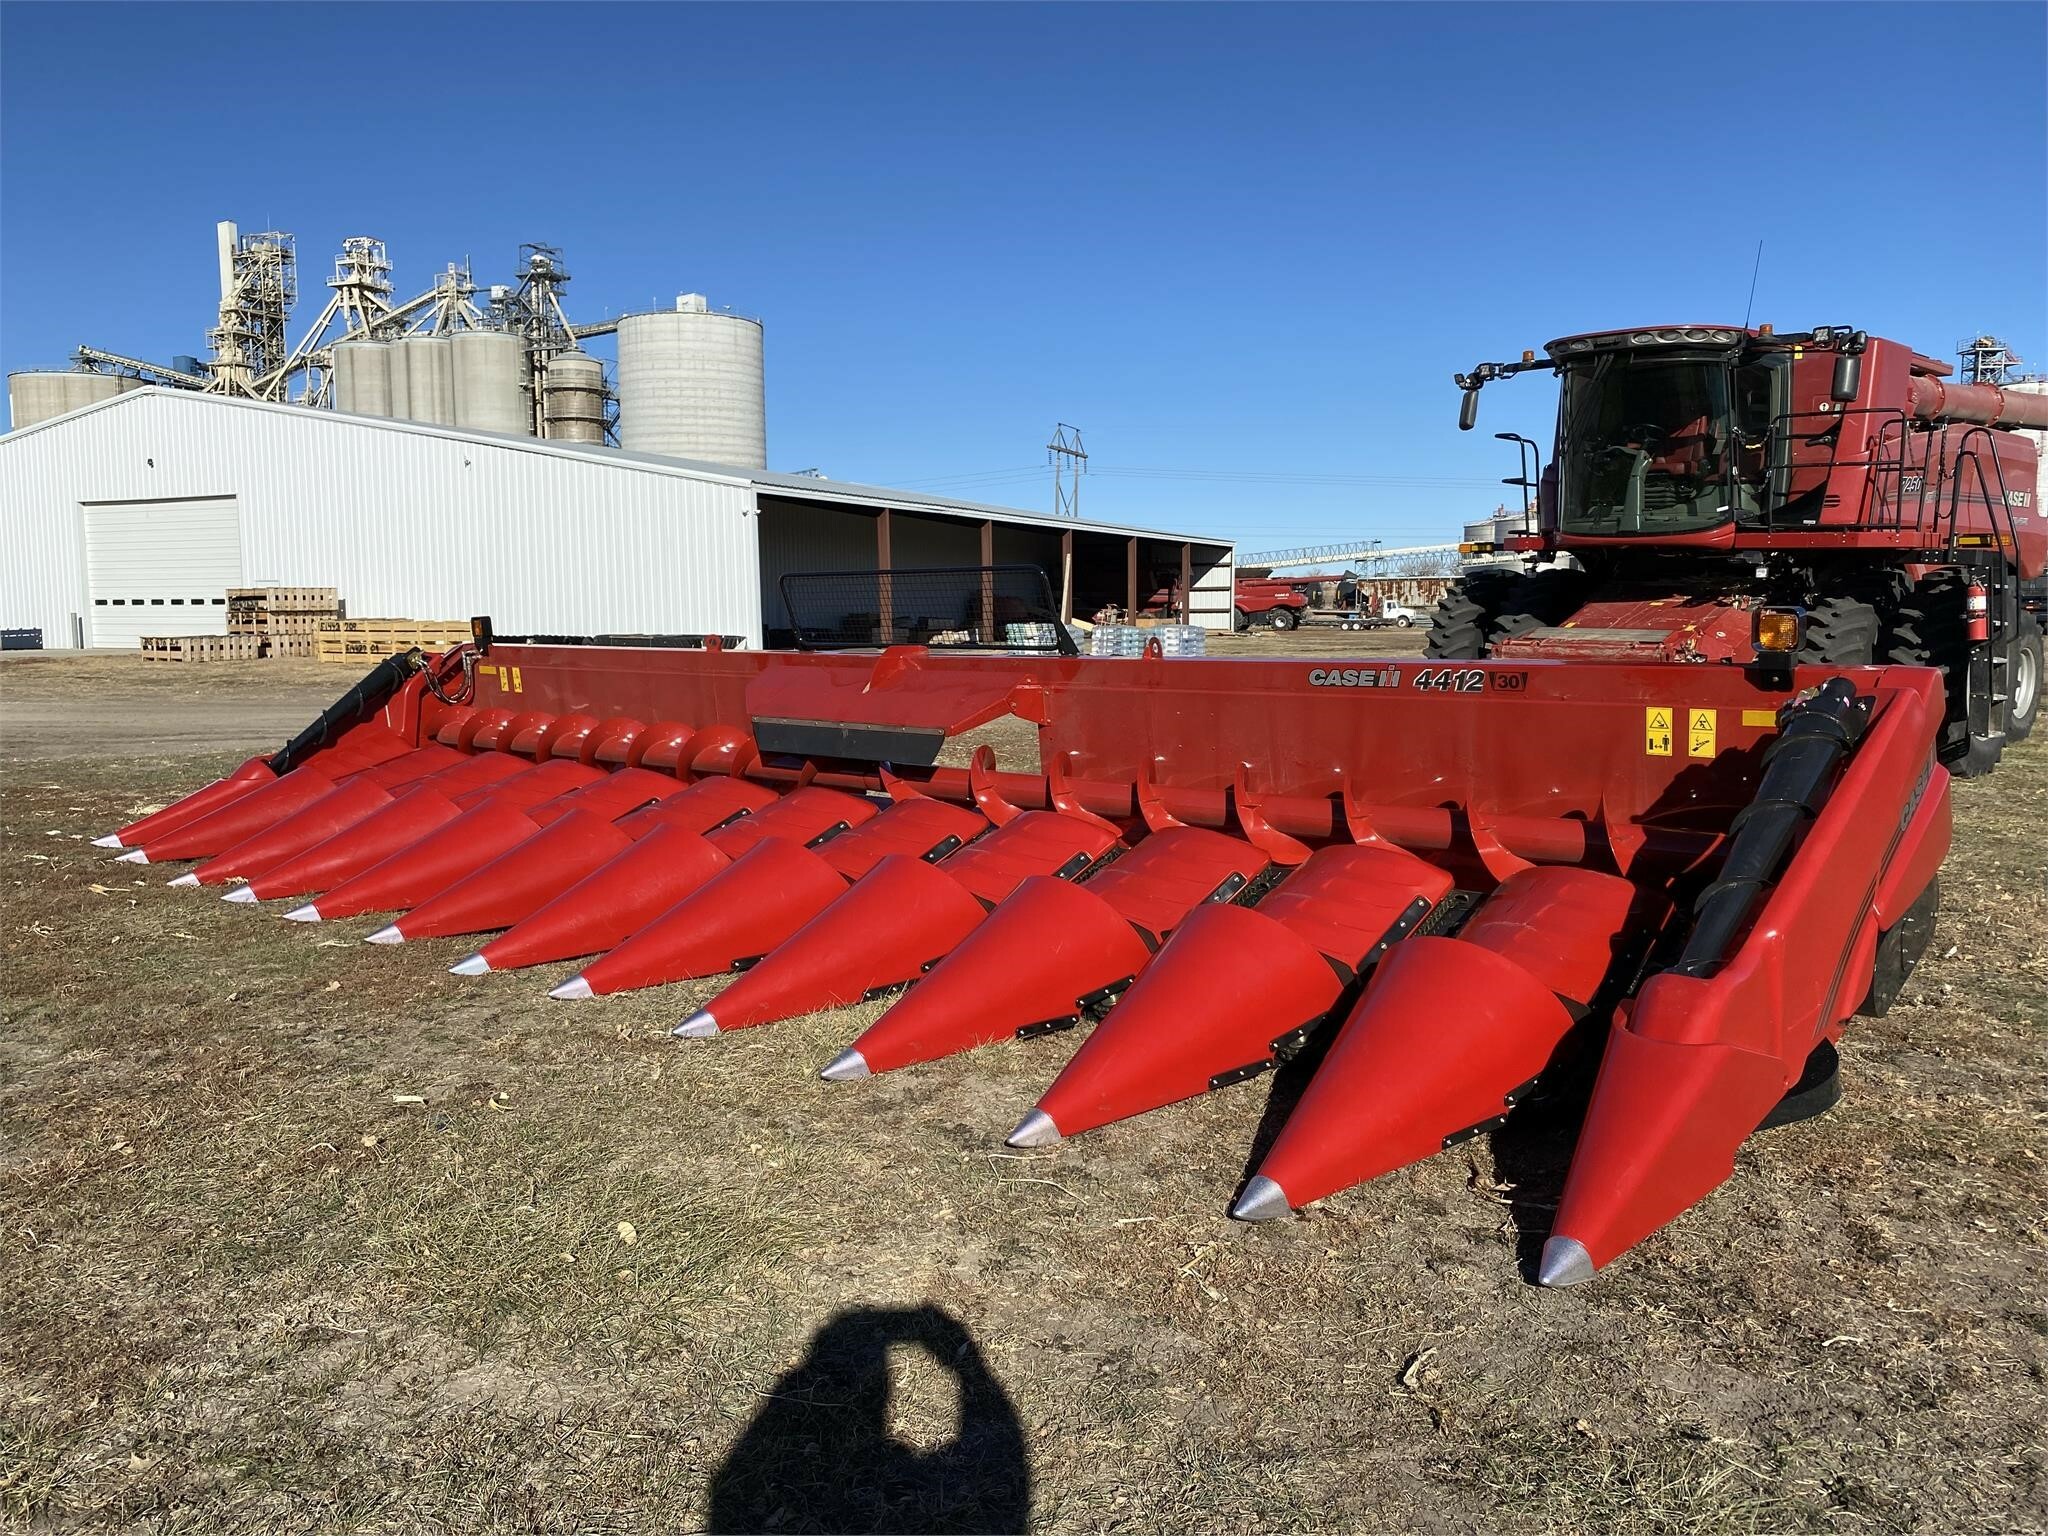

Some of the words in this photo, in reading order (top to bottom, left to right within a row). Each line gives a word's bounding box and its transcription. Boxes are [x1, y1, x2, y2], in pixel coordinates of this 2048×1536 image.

[1308, 669, 1376, 687] CASE
[1413, 668, 1485, 693] 4412
[1497, 675, 1520, 689] 30
